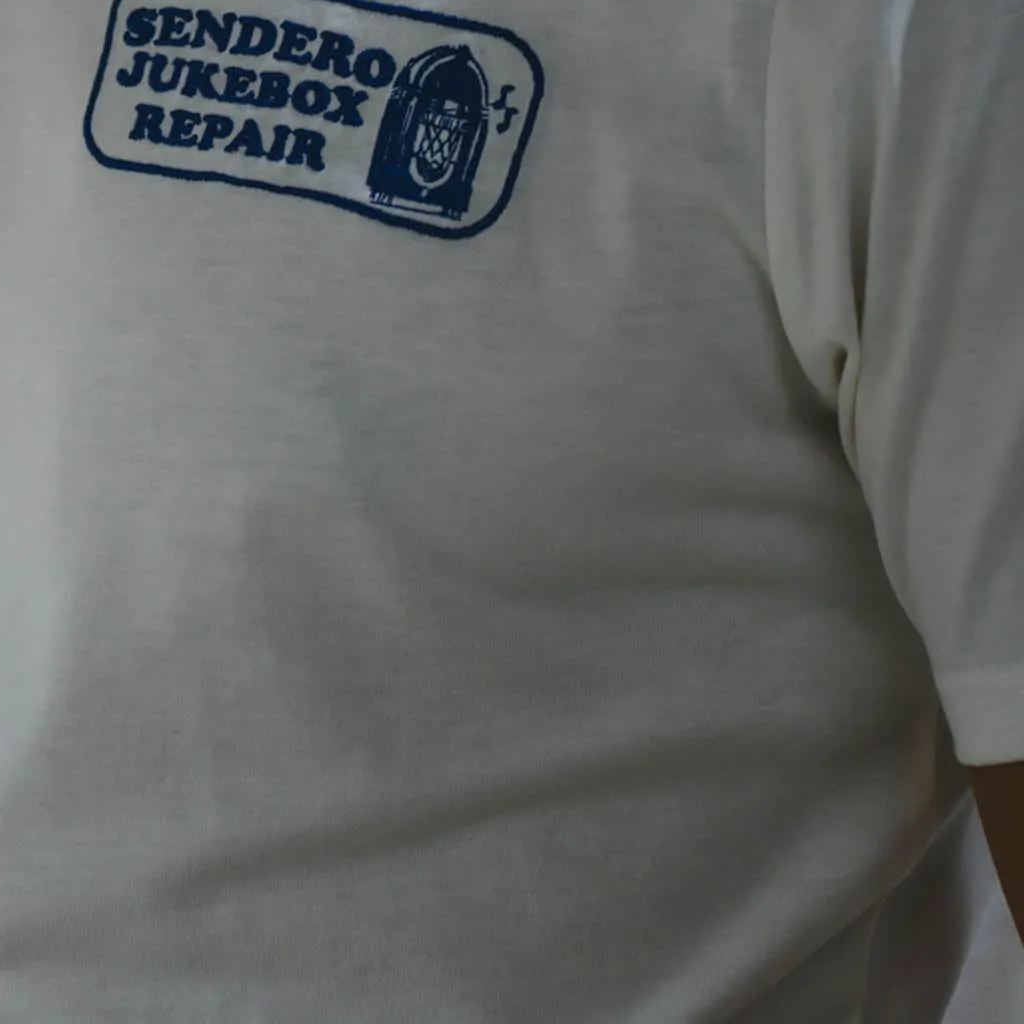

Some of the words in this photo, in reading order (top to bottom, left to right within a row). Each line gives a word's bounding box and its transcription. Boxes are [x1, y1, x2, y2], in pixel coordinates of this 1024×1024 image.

[123, 7, 396, 87] SENDERO
[116, 52, 369, 127] JUKEBOX
[128, 103, 326, 171] REPAIR
